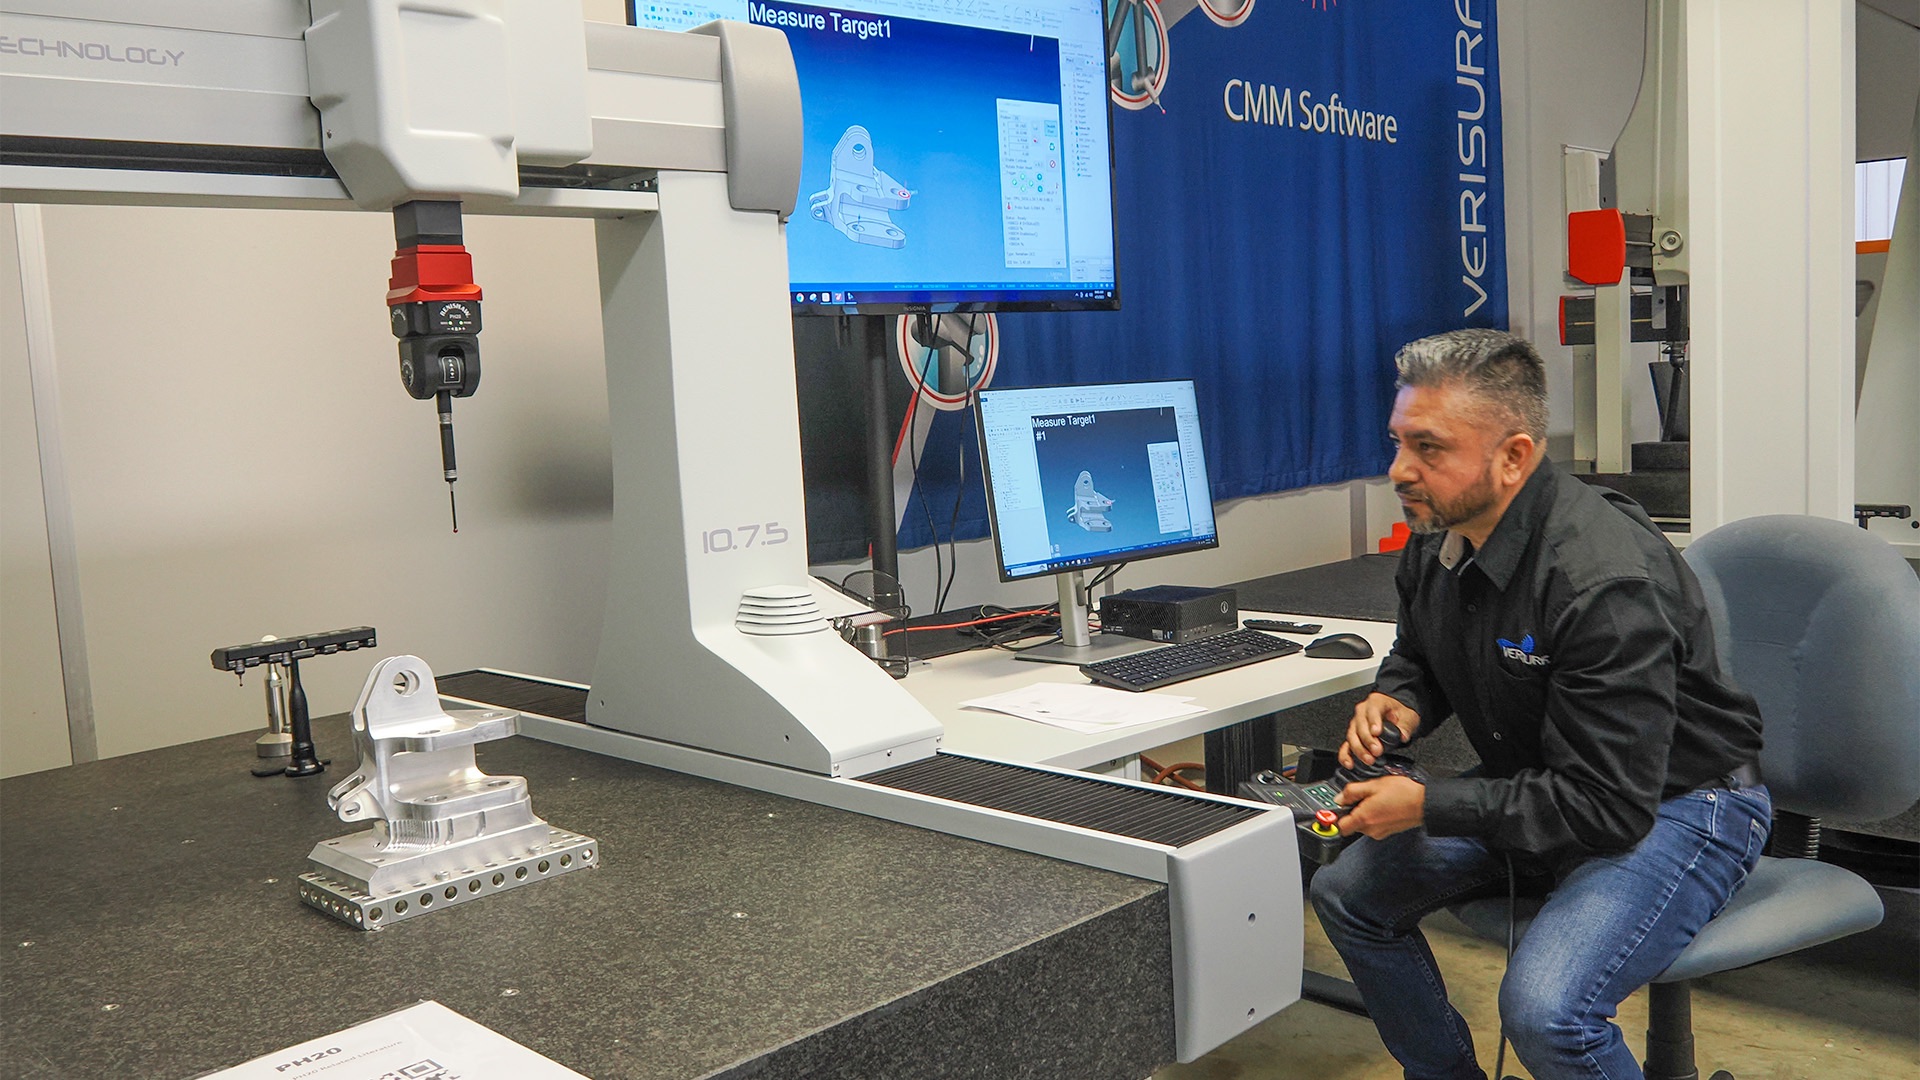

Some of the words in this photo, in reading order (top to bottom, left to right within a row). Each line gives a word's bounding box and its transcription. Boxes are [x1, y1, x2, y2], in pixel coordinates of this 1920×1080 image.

[749, 2, 826, 30] Measure
[829, 12, 891, 40] Target1
[1224, 79, 1294, 128] CMM
[1298, 90, 1398, 143] Software
[1031, 417, 1066, 428] Measure
[1067, 414, 1096, 427] Target1
[1036, 431, 1047, 441] #1
[703, 522, 789, 554] 10.7.5
[276, 1047, 343, 1073] PH20
[320, 1055, 357, 1072] Related
[358, 1041, 403, 1059] Literature
